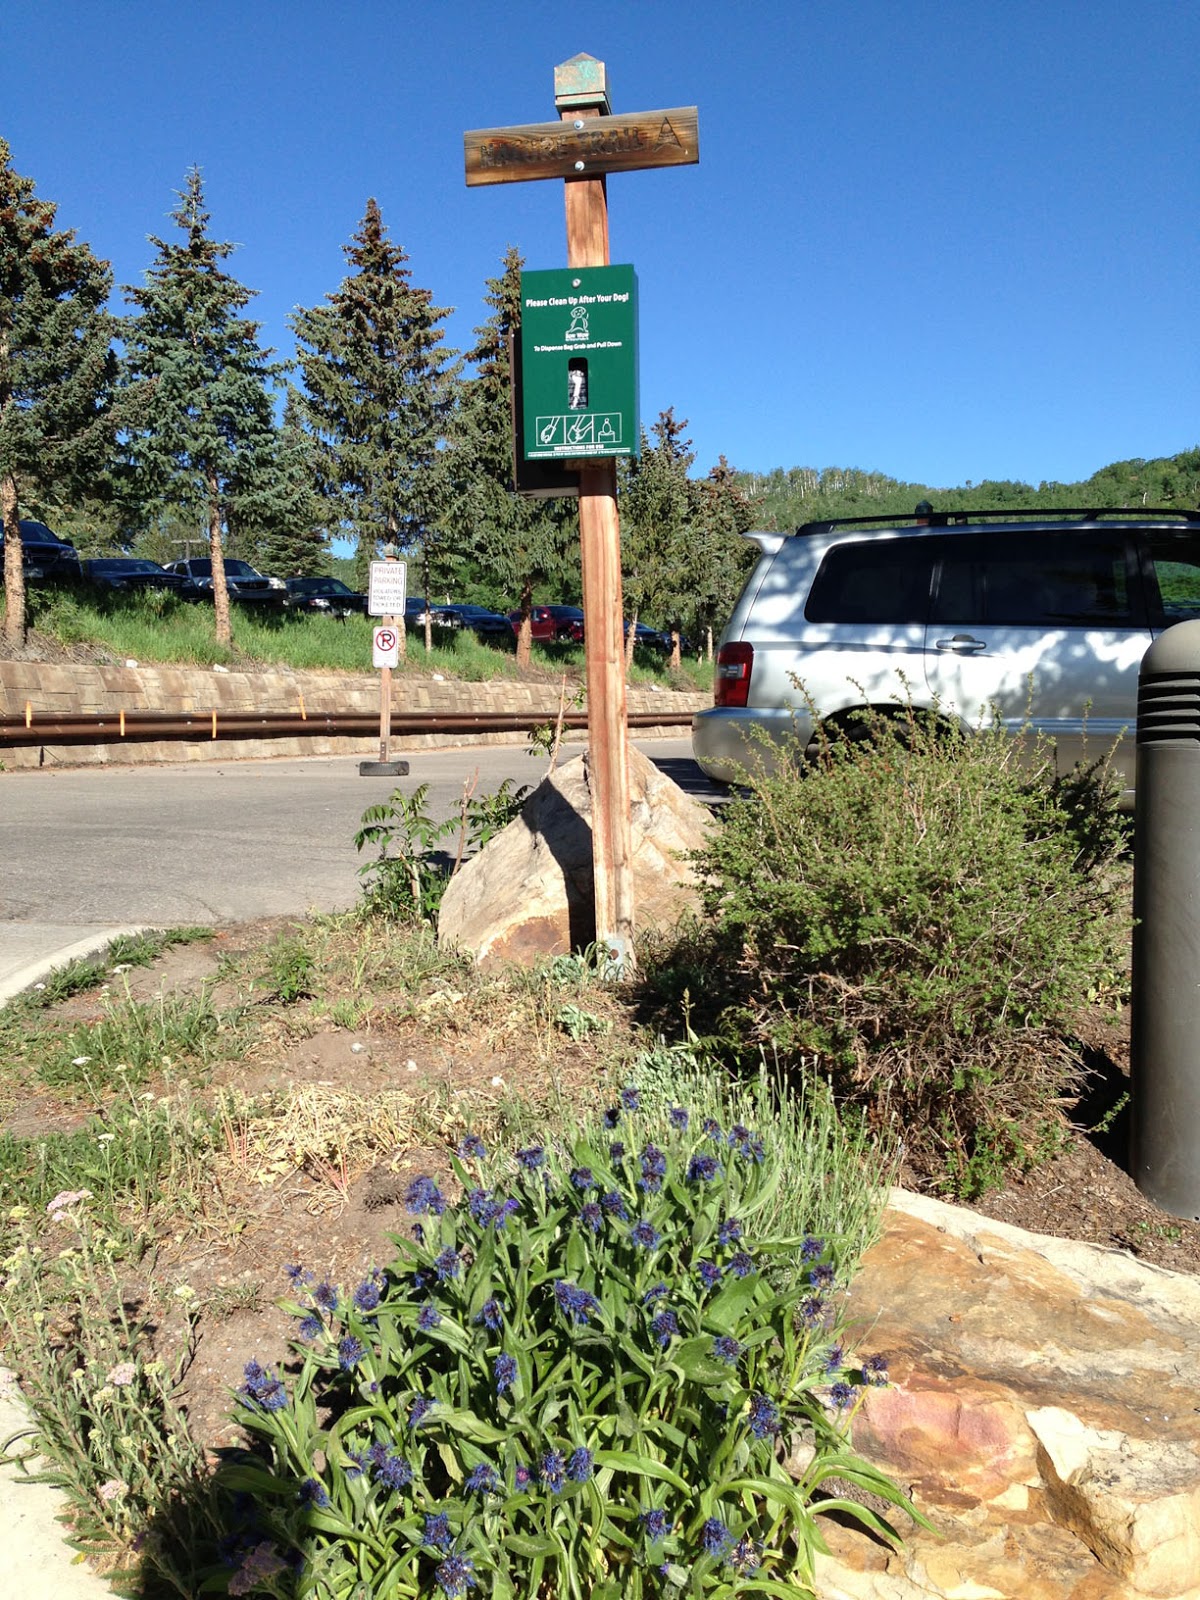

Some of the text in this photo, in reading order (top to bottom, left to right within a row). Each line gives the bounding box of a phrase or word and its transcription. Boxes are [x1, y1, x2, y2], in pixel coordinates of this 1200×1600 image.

[526, 292, 629, 307] Please Clean Up After Your Dog!
[374, 566, 403, 575] PRIVATE
[374, 576, 403, 586] PARKING
